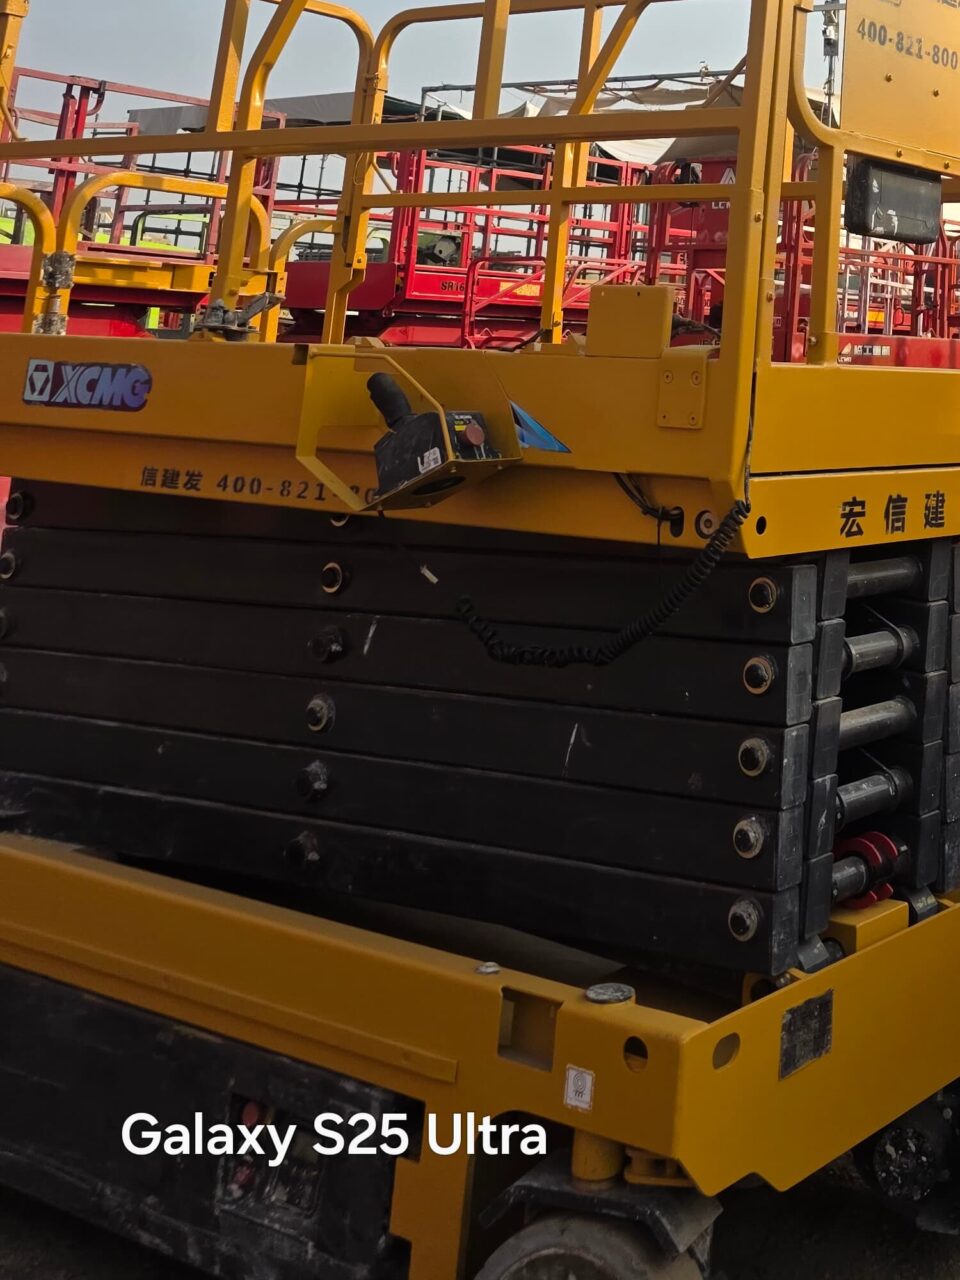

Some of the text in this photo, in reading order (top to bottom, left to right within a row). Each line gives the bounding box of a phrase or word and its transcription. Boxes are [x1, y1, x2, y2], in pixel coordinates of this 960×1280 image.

[52, 364, 151, 408] XCMG
[141, 466, 204, 492] 信建发
